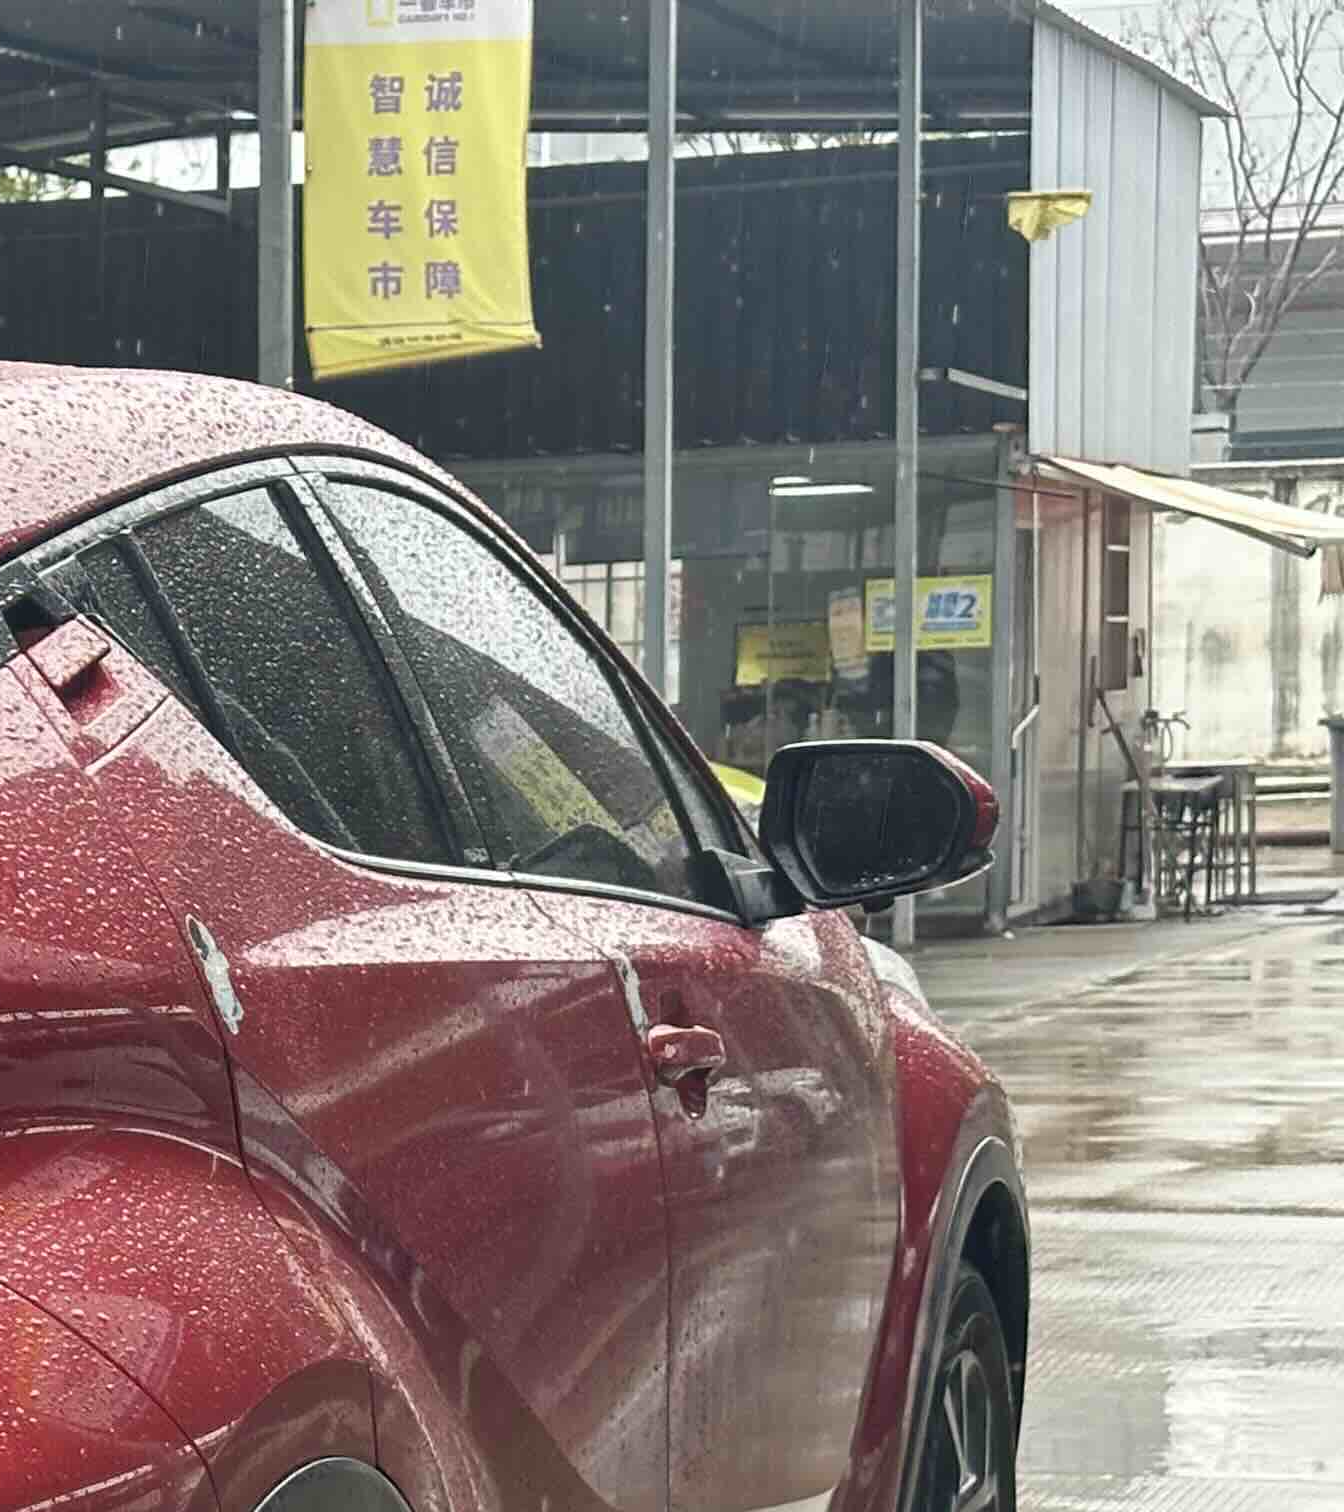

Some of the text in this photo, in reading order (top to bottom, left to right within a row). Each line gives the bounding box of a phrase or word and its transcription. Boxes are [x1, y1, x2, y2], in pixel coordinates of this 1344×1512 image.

[367, 74, 405, 300] 智慧车市
[423, 71, 463, 300] 诚信保障
